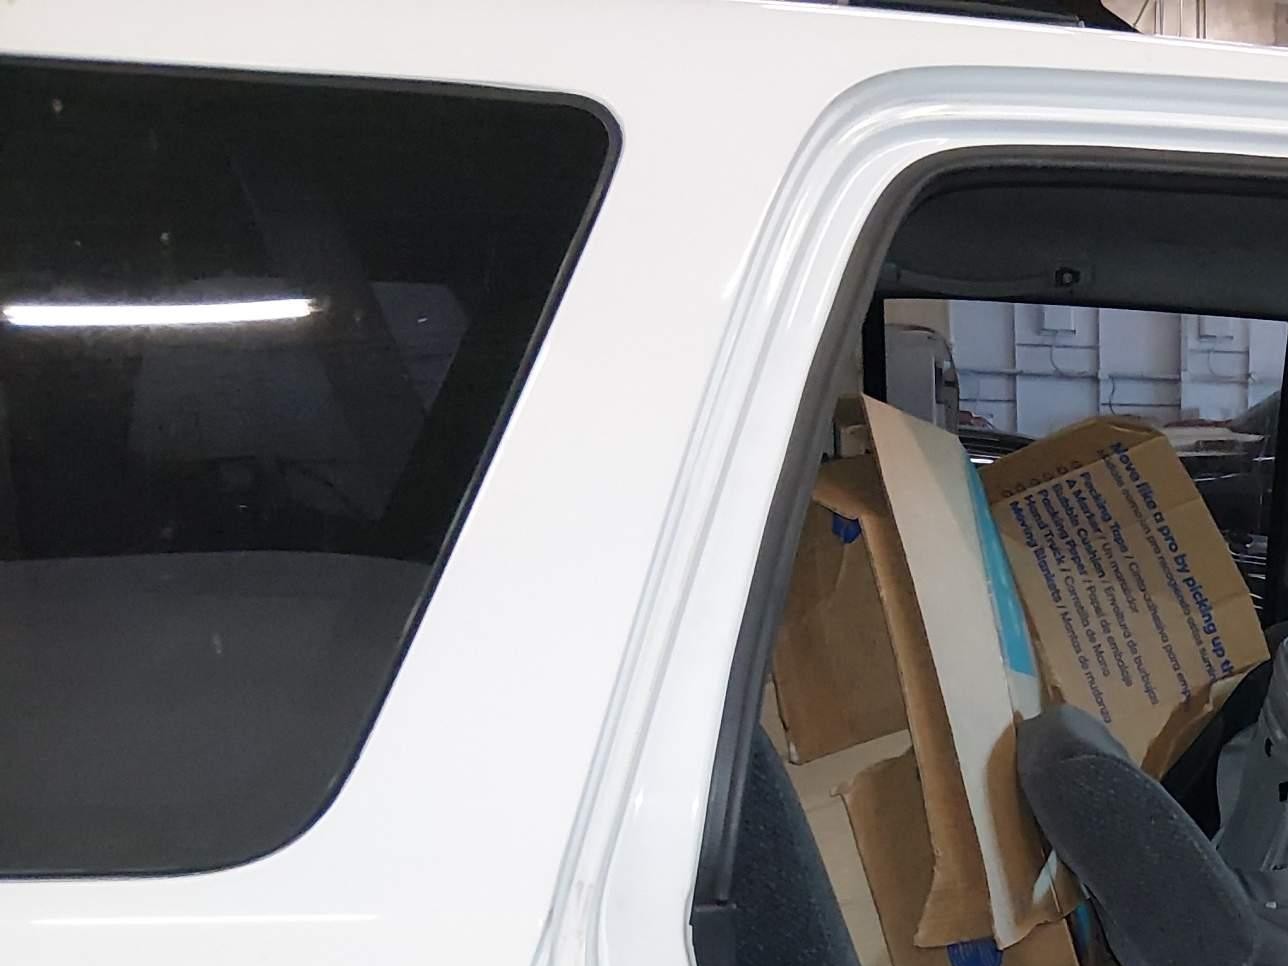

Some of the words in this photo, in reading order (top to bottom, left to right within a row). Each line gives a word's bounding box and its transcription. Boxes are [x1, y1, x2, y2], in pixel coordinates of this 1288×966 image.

[1025, 495, 1047, 529] Hand
[1044, 530, 1065, 564] Truck
[1065, 575, 1091, 626] Carretilla
[1086, 628, 1097, 643] de
[1094, 644, 1110, 676] Mano
[1039, 489, 1068, 539] Packing
[1065, 539, 1086, 575] Paper
[1087, 585, 1105, 617] Papel
[1101, 619, 1111, 634] de
[1107, 635, 1132, 687] embalaje
[1052, 483, 1080, 526] Bubble
[1076, 527, 1105, 577] Cushion
[1105, 587, 1131, 637] Envoltura
[1127, 639, 1137, 653] de
[1135, 656, 1158, 705] burbujas
[1065, 479, 1078, 489] A
[1073, 489, 1100, 533] Marker
[1080, 471, 1112, 522] Packing
[1109, 522, 1128, 552] Tape
[1163, 644, 1180, 670] para
[1112, 443, 1139, 481] Move
[1137, 482, 1156, 510] like
[1153, 512, 1163, 522] a
[1158, 525, 1177, 552] pro
[1174, 553, 1188, 575] by
[1183, 575, 1216, 634] picking
[1211, 636, 1225, 657] up
[1010, 501, 1036, 548] Moving
[1034, 547, 1061, 602] Blankets
[1062, 612, 1081, 652] Mantas
[1079, 655, 1088, 670] de
[1085, 672, 1111, 723] mudanza
